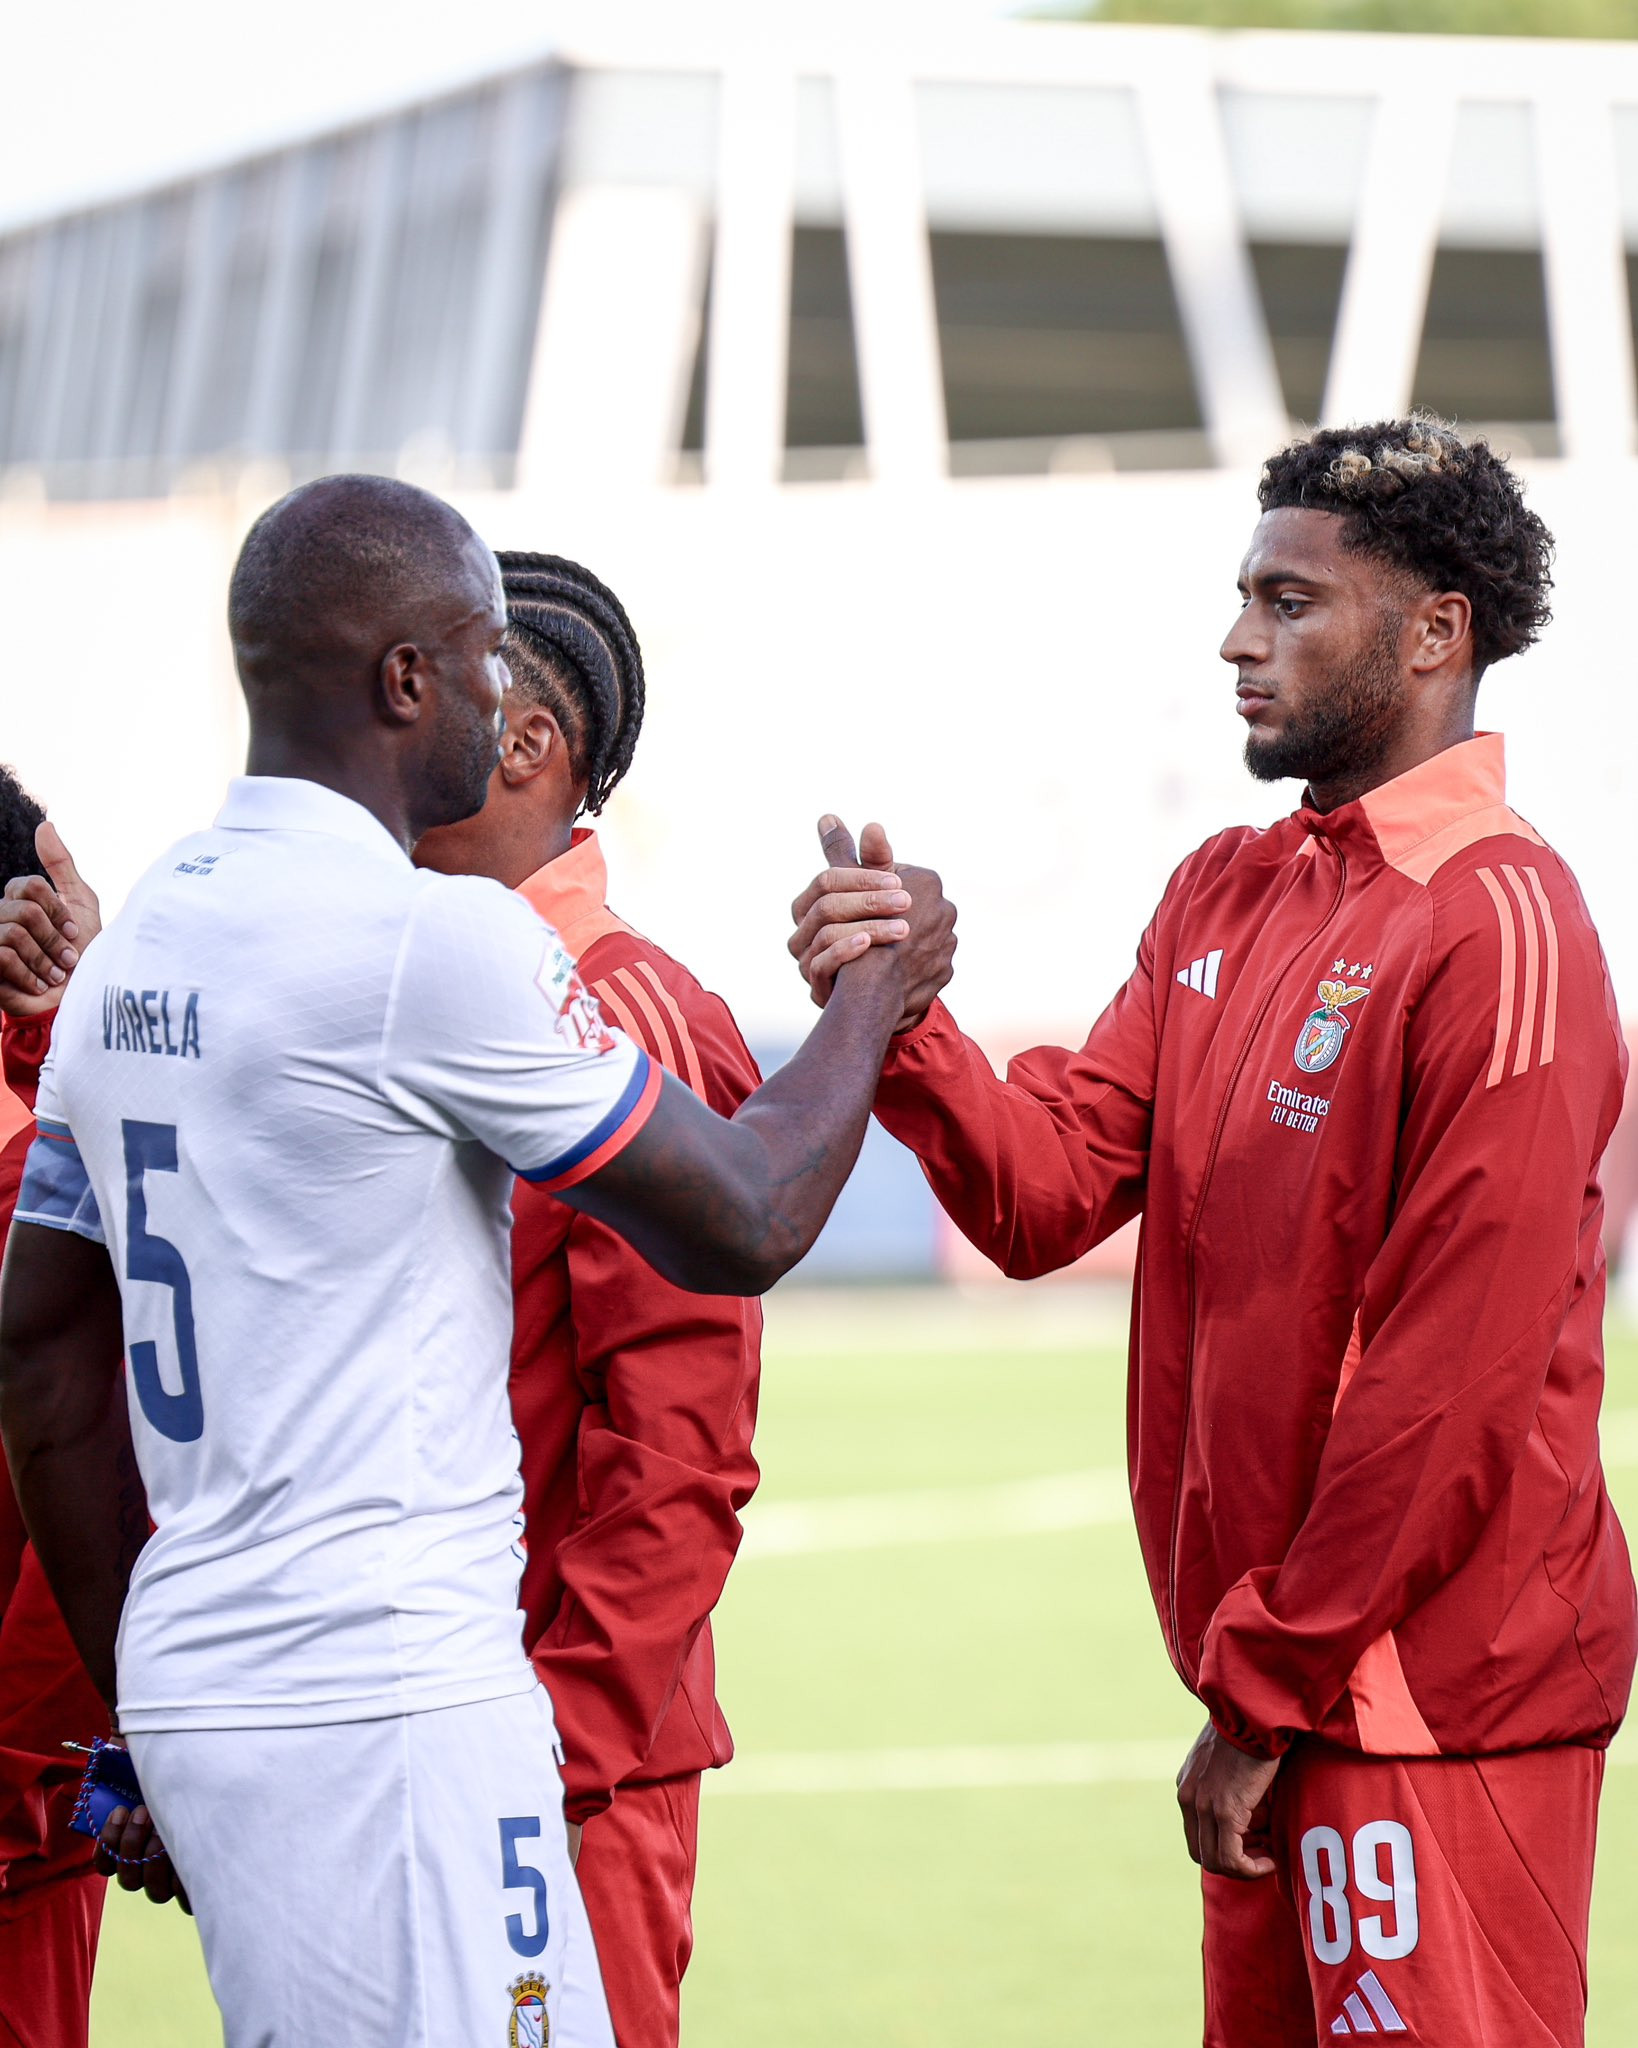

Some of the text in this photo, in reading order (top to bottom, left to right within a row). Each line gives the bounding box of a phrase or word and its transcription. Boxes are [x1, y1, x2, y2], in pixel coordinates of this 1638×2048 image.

[103, 985, 200, 1058] VARELA
[1267, 1080, 1331, 1116] Emirates
[1270, 1105, 1319, 1133] FLY BETTER
[121, 1118, 204, 1443] 5
[498, 1816, 549, 1957] 5
[1301, 1820, 1419, 1965] 89
